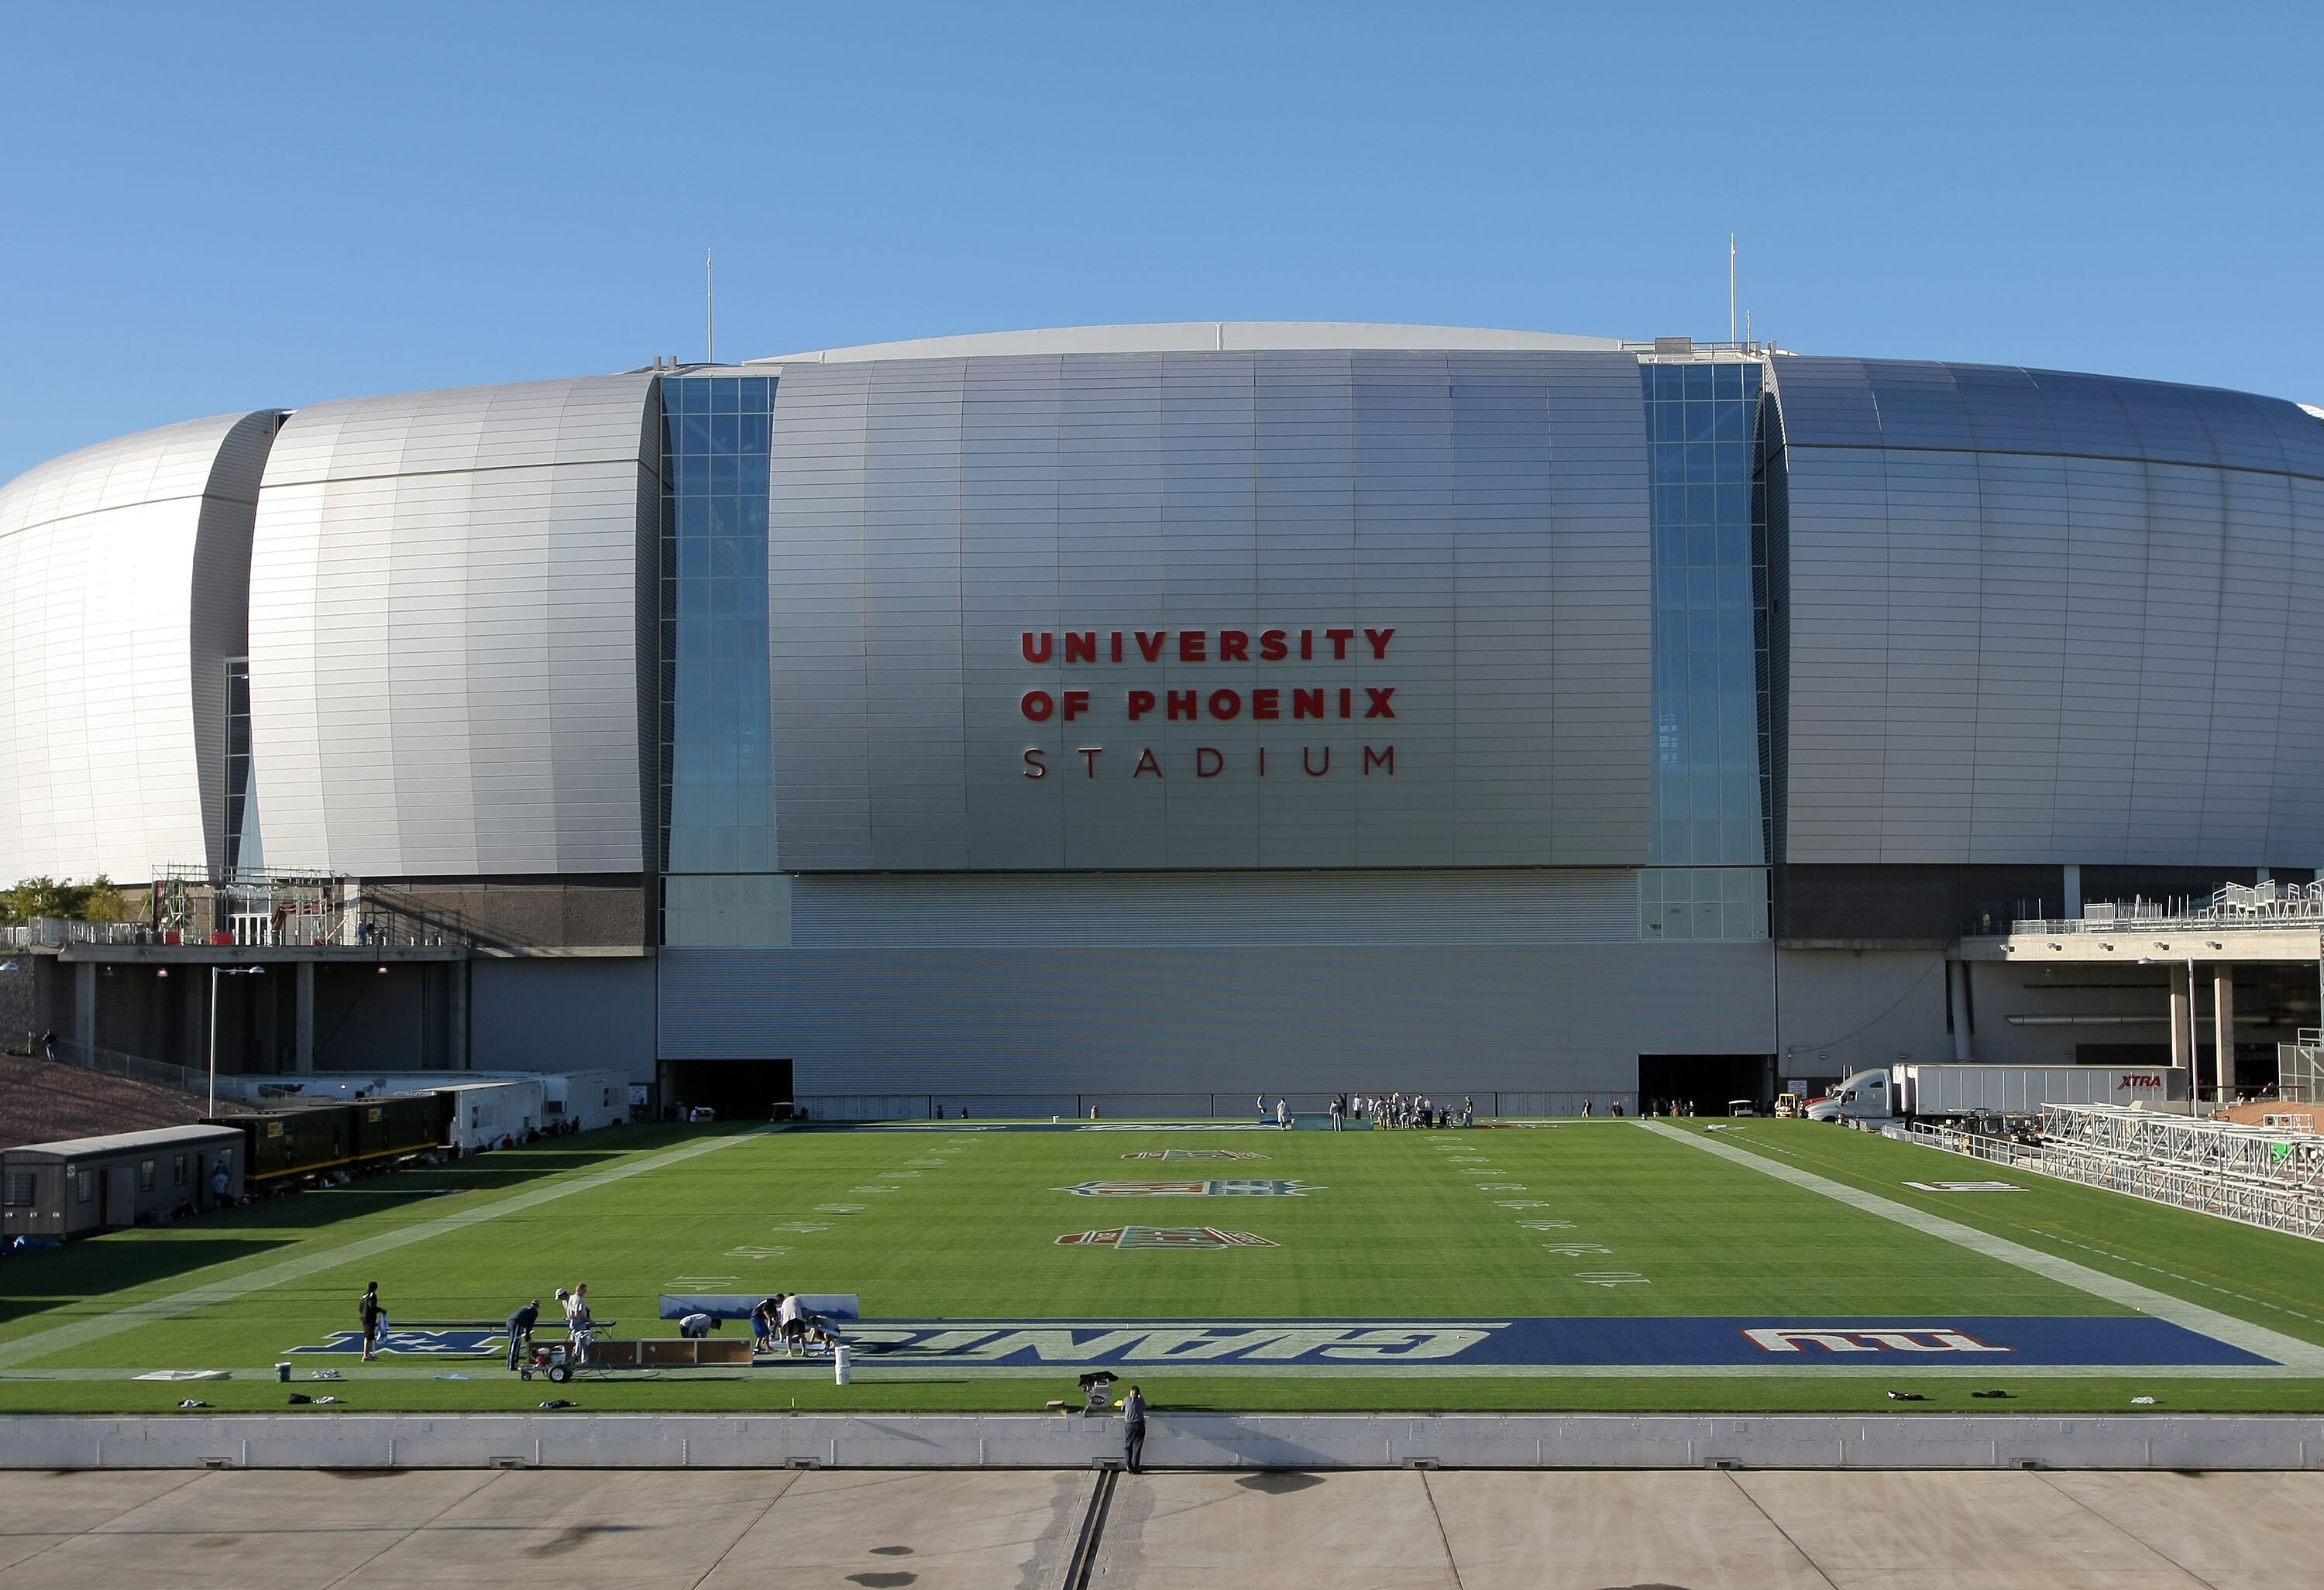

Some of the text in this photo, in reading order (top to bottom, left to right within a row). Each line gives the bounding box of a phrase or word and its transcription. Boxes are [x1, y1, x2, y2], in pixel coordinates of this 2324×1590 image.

[1021, 628, 1396, 663] UNIVERSITY
[1021, 688, 1396, 721] OF PHOENIX
[1023, 746, 1394, 778] STADIUM
[2117, 1074, 2161, 1090] XTRA
[1541, 1243, 1613, 1254] 20
[663, 1276, 742, 1288] 10
[1574, 1272, 1652, 1284] 10
